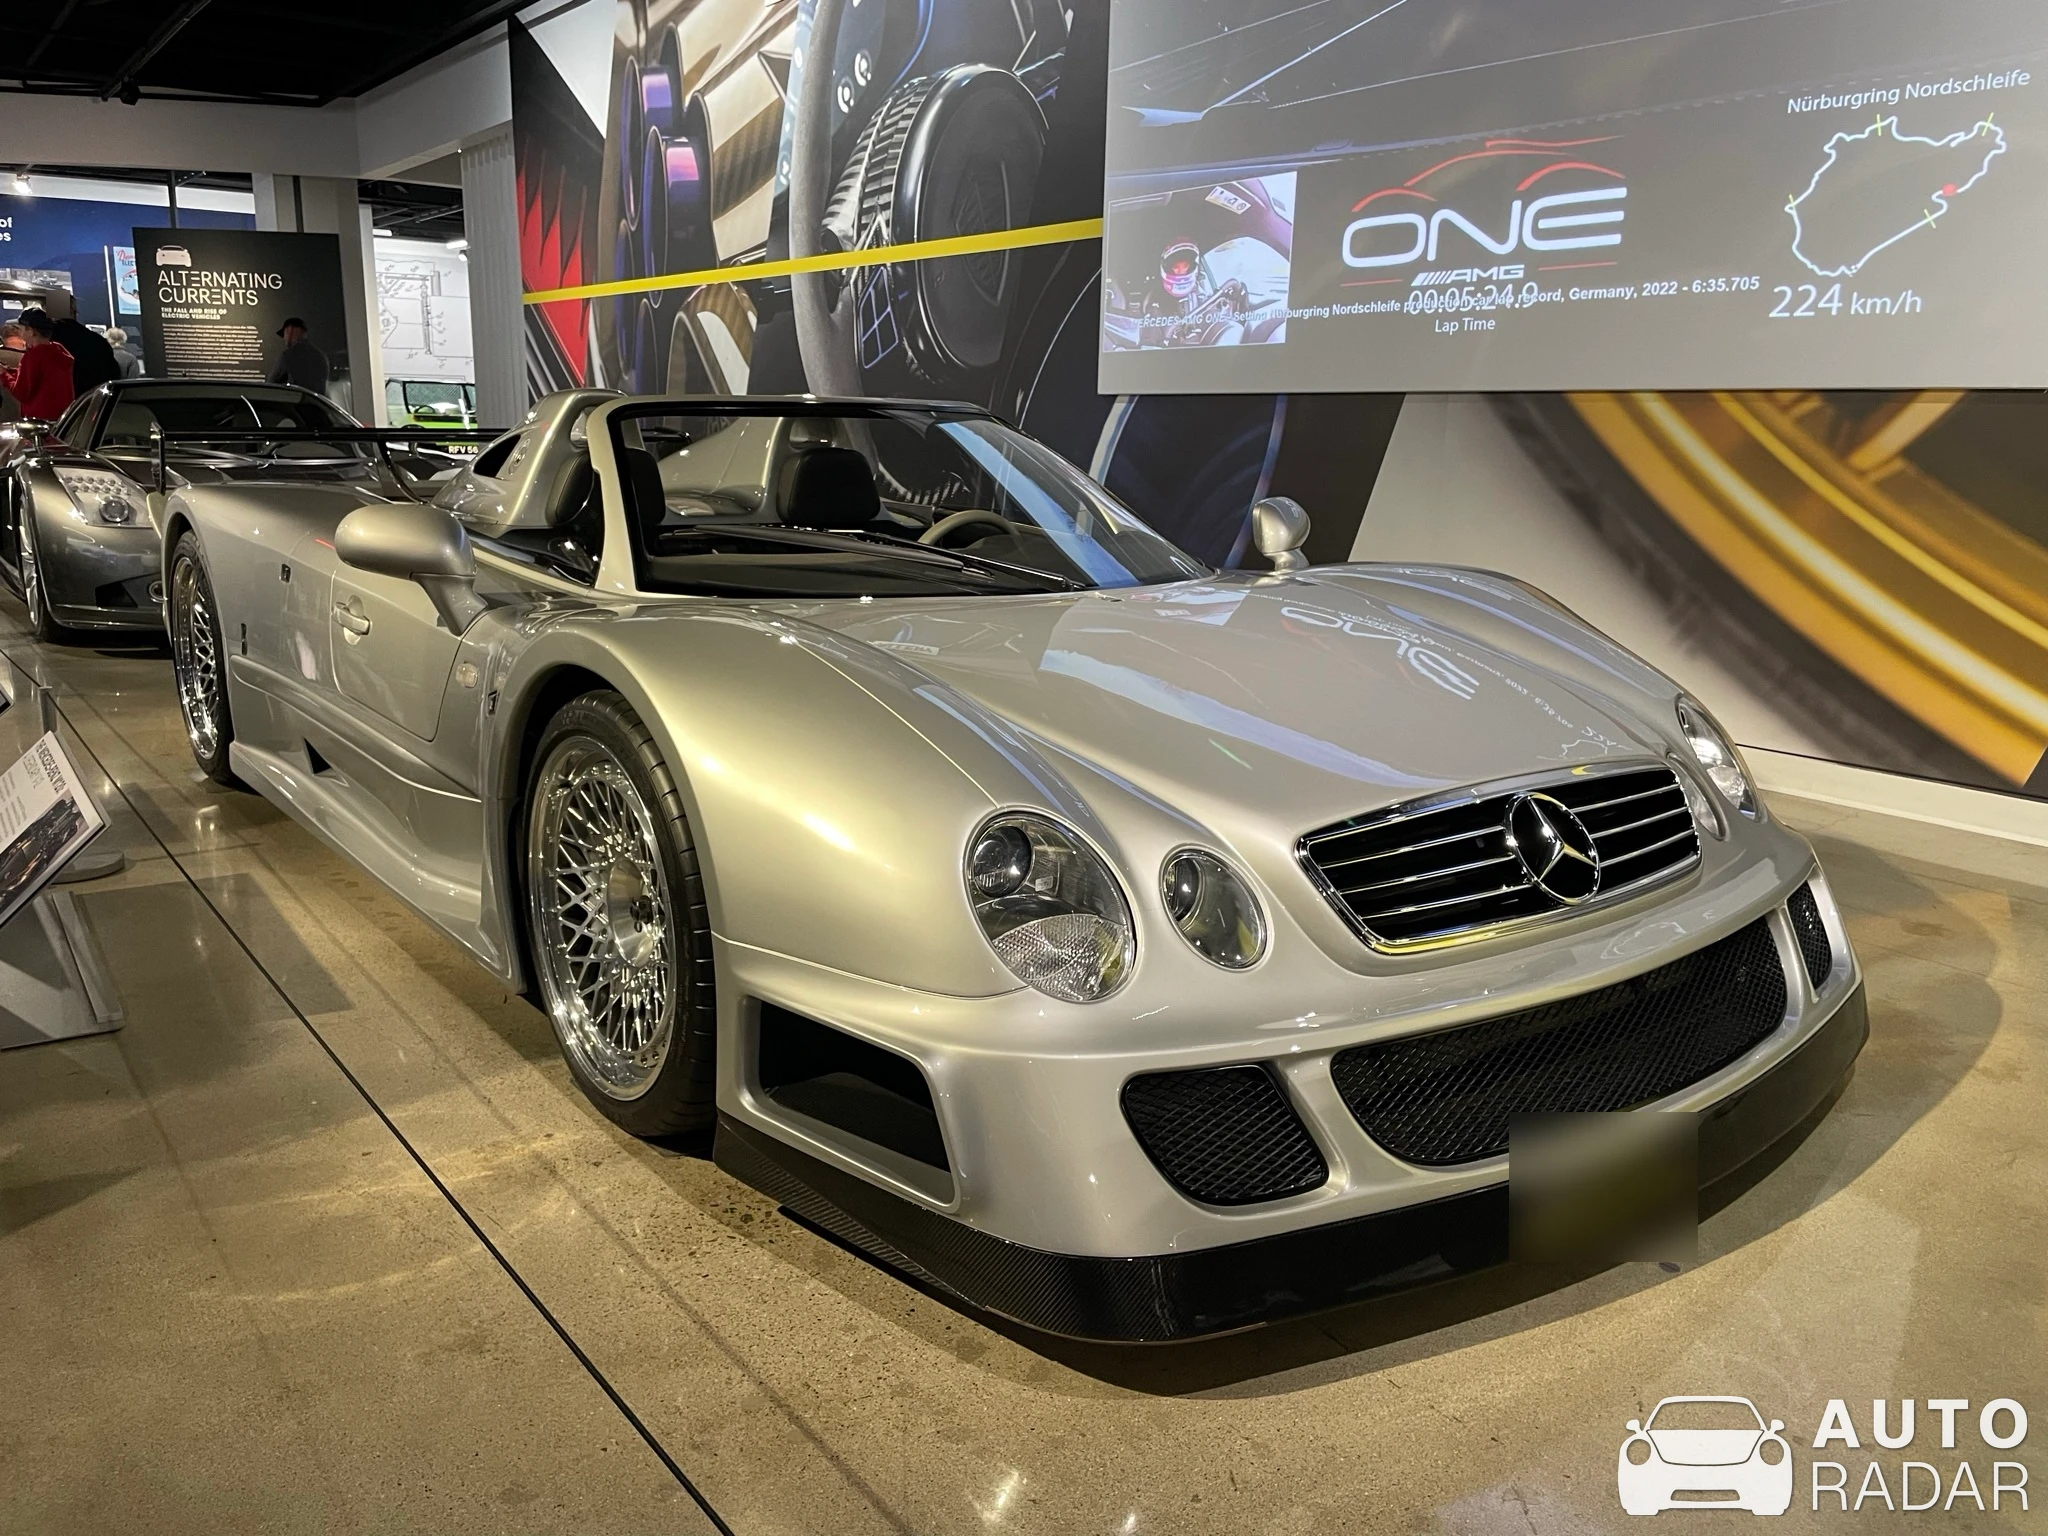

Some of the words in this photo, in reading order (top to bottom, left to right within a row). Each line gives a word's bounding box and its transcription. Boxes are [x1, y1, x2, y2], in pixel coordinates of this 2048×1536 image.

[1787, 87, 1900, 114] Nürburgring
[1905, 69, 2031, 100] Nordschleife
[1342, 187, 1628, 268] ONE
[157, 270, 283, 290] ALTERNATING
[1446, 264, 1525, 284] AMG
[158, 287, 259, 306] CURRENTS
[1332, 300, 1401, 315] Nordschleife
[1568, 285, 1638, 300] Germany,
[1641, 281, 1678, 296] 2022
[1691, 275, 1760, 293] 6:35.705
[1768, 283, 1844, 318] 224
[1850, 289, 1922, 315] km/h
[1434, 319, 1459, 335] Lap
[1462, 317, 1496, 331] Time
[448, 445, 466, 454] RFV
